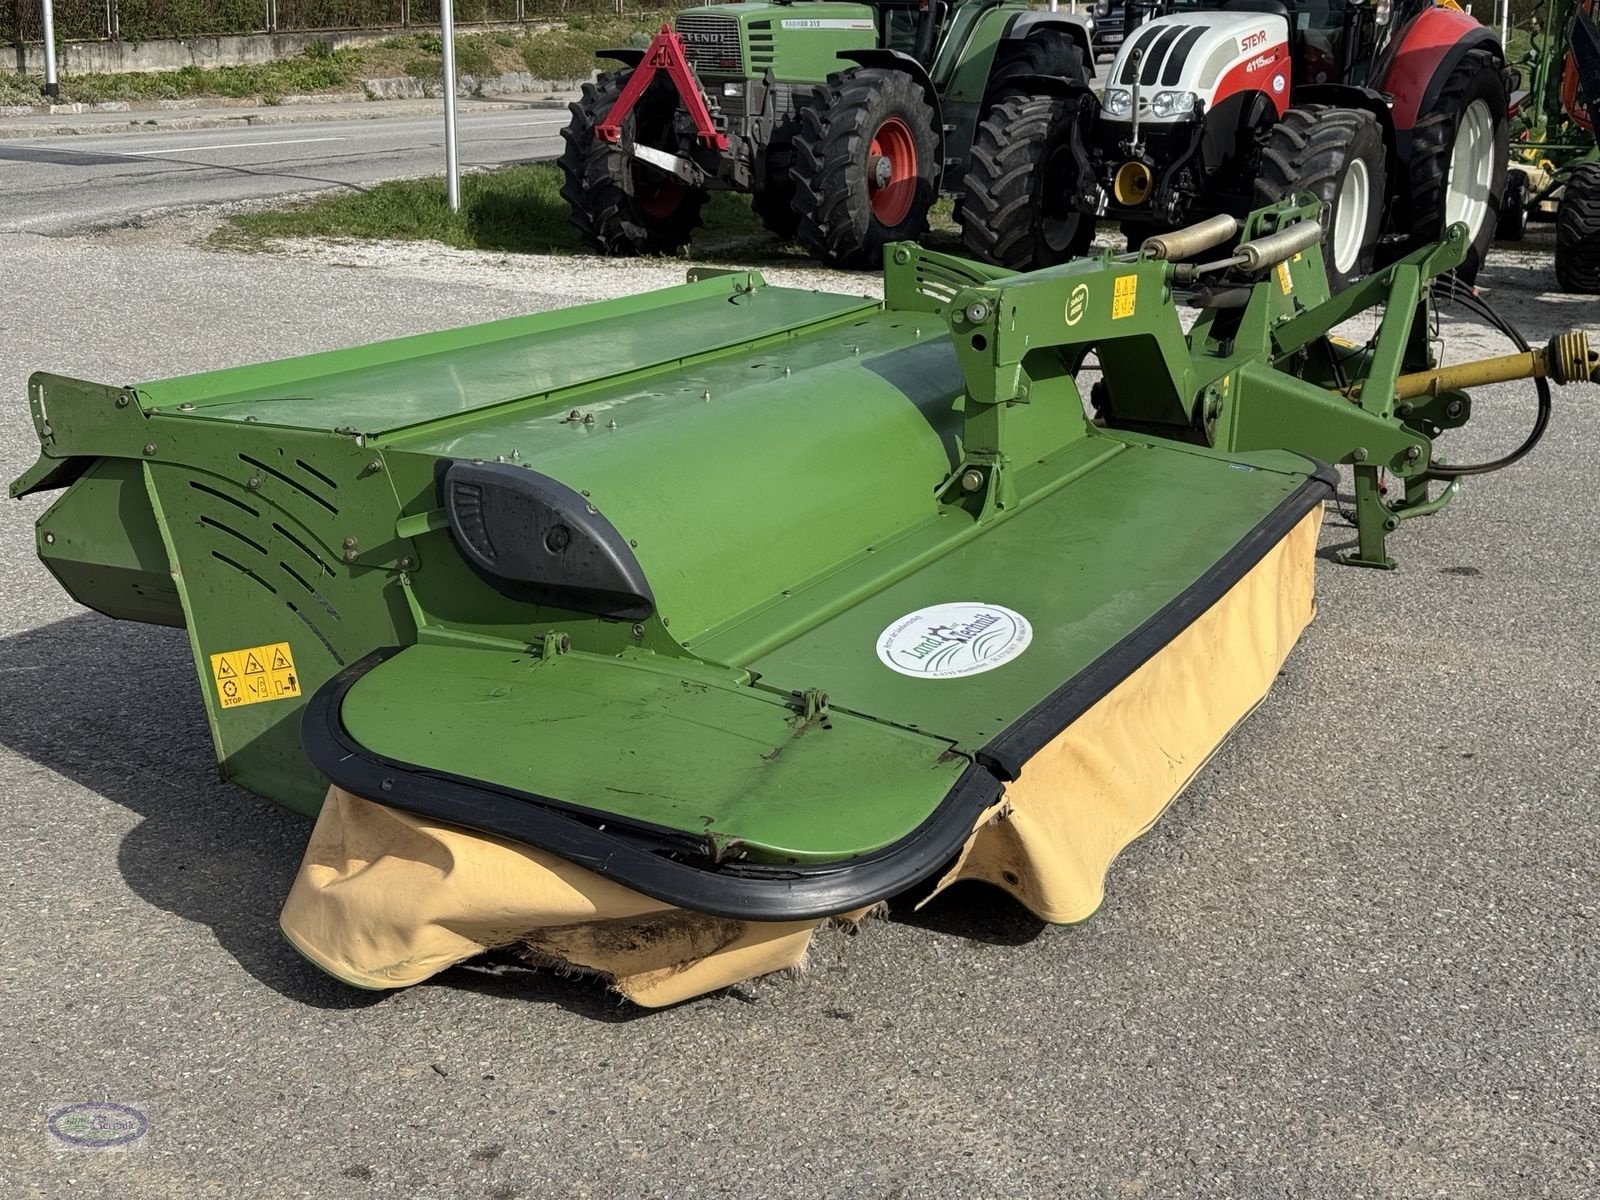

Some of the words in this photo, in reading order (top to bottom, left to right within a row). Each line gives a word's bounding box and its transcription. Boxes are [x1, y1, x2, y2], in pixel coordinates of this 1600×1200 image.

[687, 33, 725, 42] FENDT
[1241, 30, 1267, 52] STEYR
[1246, 55, 1265, 72] 4115
[901, 635, 944, 659] Land
[950, 613, 1002, 643] Technik
[224, 697, 242, 706] STOP
